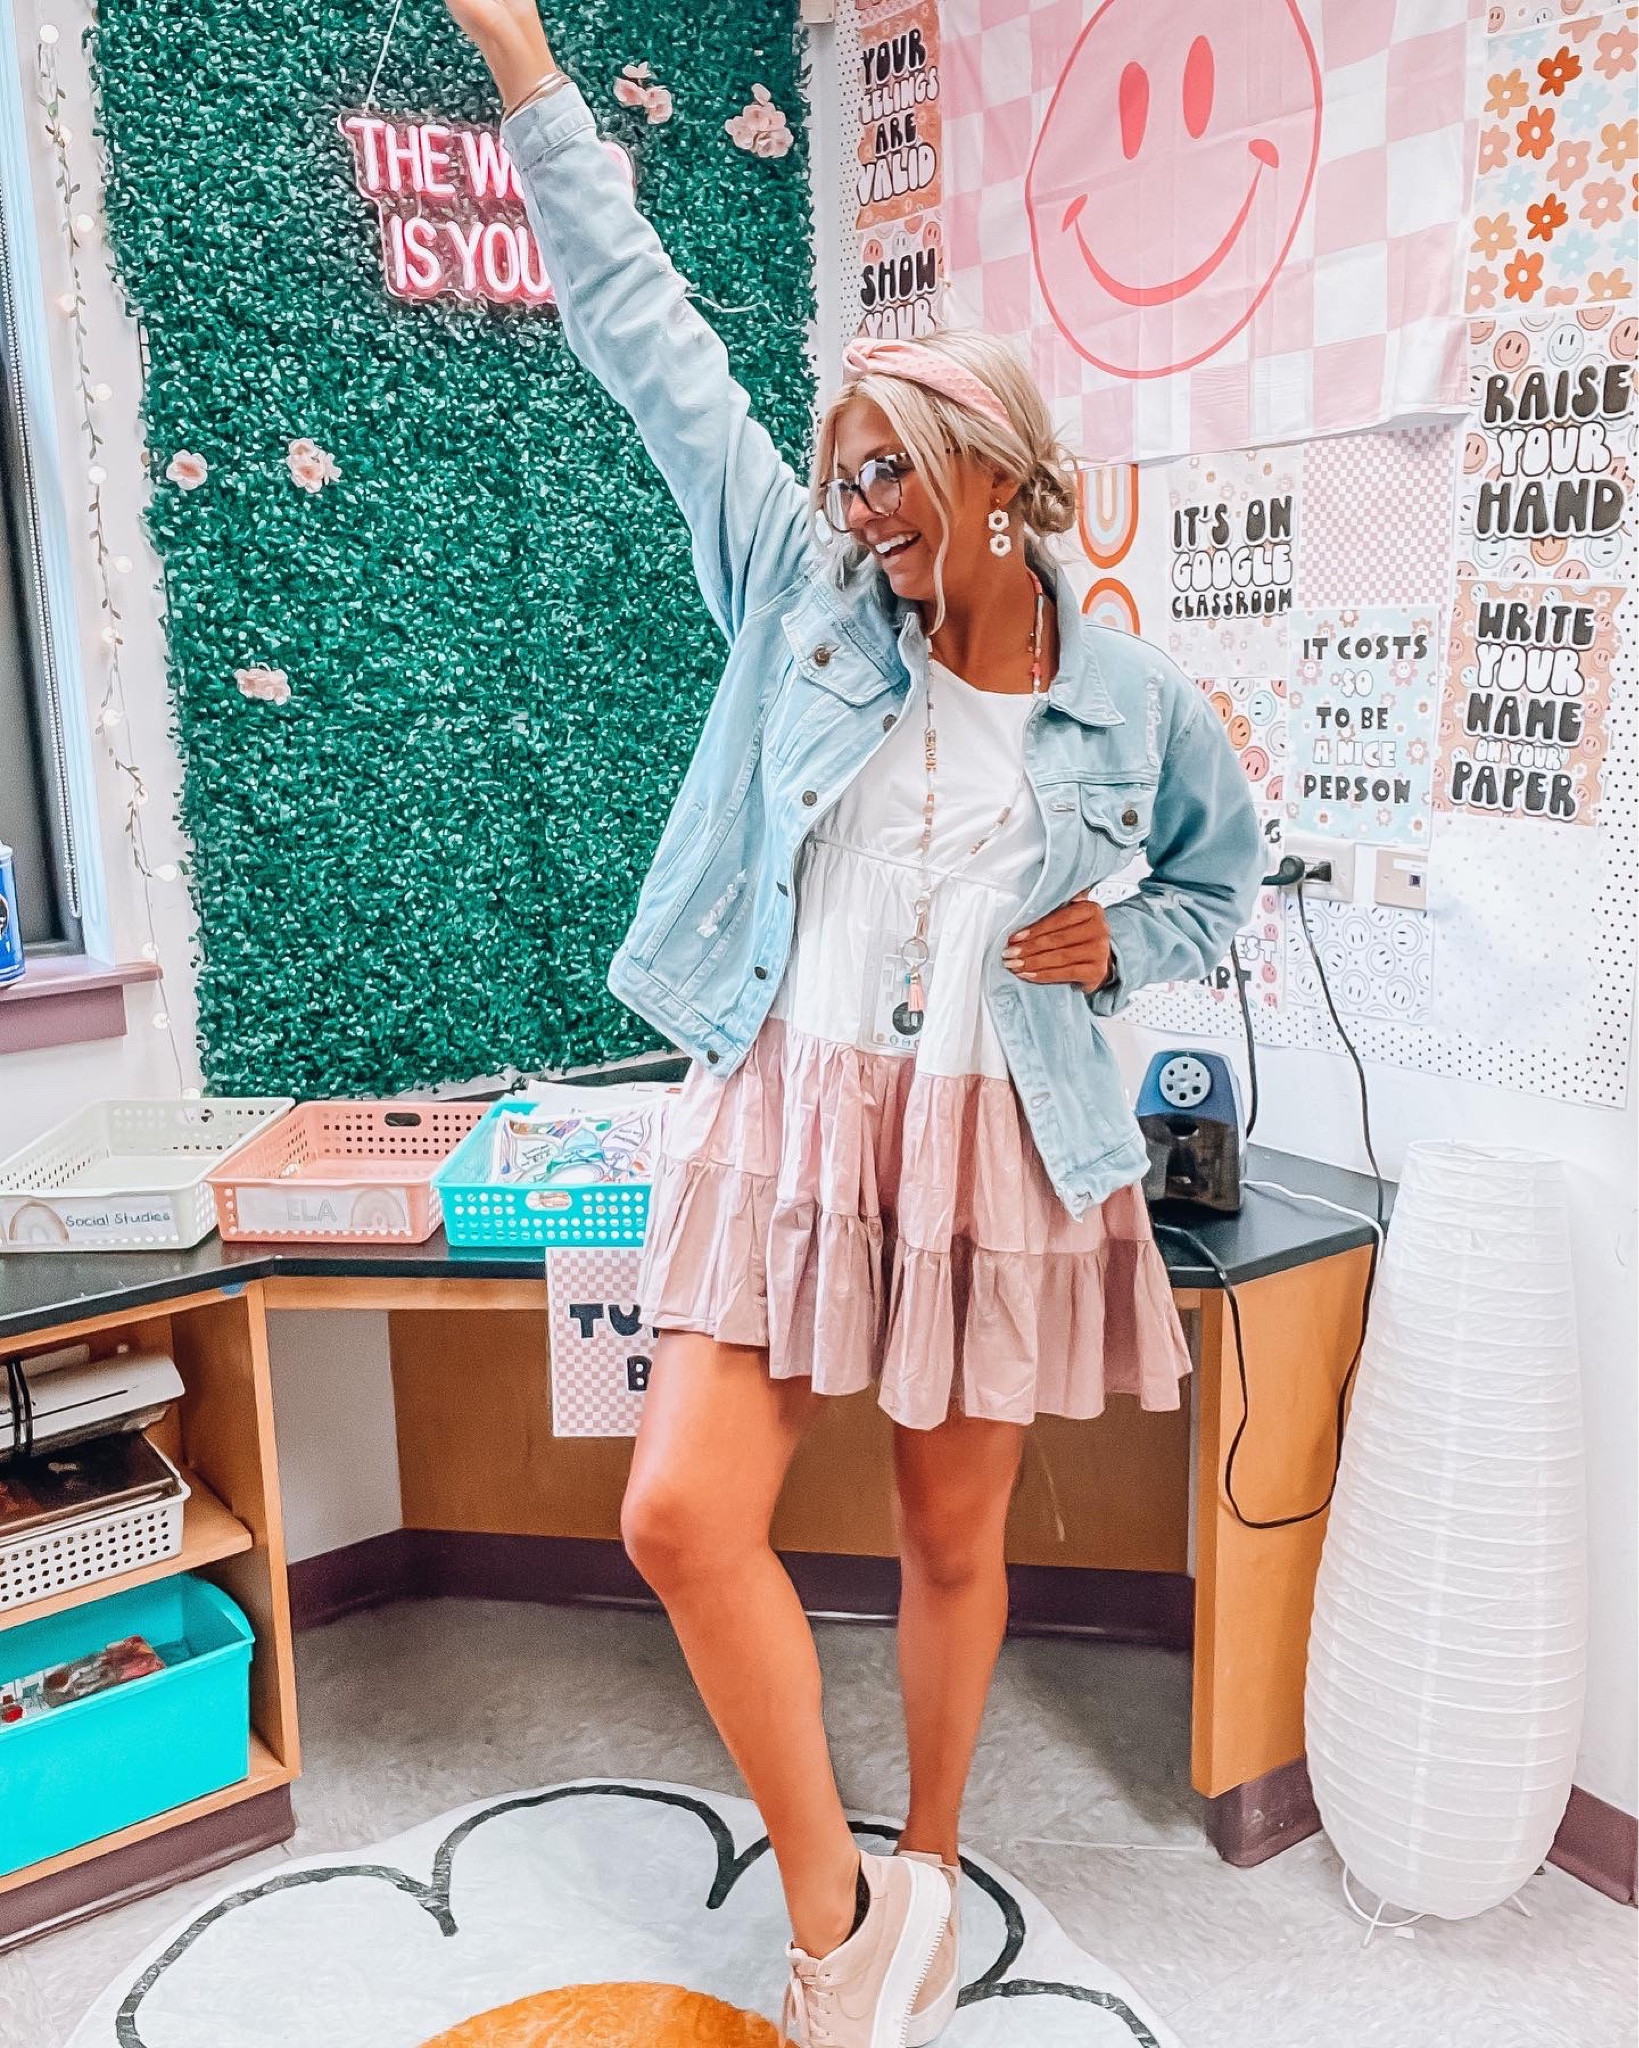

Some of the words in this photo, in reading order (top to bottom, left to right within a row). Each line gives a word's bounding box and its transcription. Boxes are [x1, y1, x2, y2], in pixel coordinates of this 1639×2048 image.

[862, 28, 926, 85] YOUR
[859, 65, 940, 125] EELINGS
[346, 117, 456, 194] THE
[875, 112, 917, 154] ARE
[856, 142, 937, 206] VALID
[389, 214, 440, 289] IS
[860, 248, 937, 307] SHOW
[866, 298, 936, 339] YOUR
[1484, 364, 1631, 424] RAISE
[1497, 421, 1612, 477] YOUR
[1174, 502, 1230, 549] IT'S
[1246, 495, 1292, 543] ON
[1476, 478, 1624, 535] HAND
[1171, 544, 1293, 592] GOOGLE
[1171, 588, 1292, 618] CLASSROOM
[1478, 602, 1595, 646] WRITE
[1303, 637, 1329, 660] IT
[1337, 634, 1428, 660] COSTS
[1476, 642, 1585, 697] YOUR
[1340, 668, 1374, 698] SO
[1316, 706, 1350, 729] TO
[1361, 706, 1389, 730] BE
[1466, 693, 1582, 743] NAME
[1313, 739, 1331, 765] A
[1336, 740, 1397, 769] NICE
[1474, 739, 1503, 764] ON
[1508, 742, 1562, 771] YOUR
[1303, 774, 1411, 804] PERSON
[1452, 761, 1576, 818] PAPER
[65, 1213, 109, 1228] Social
[114, 1210, 171, 1225] Studies
[286, 1198, 338, 1223] ELA
